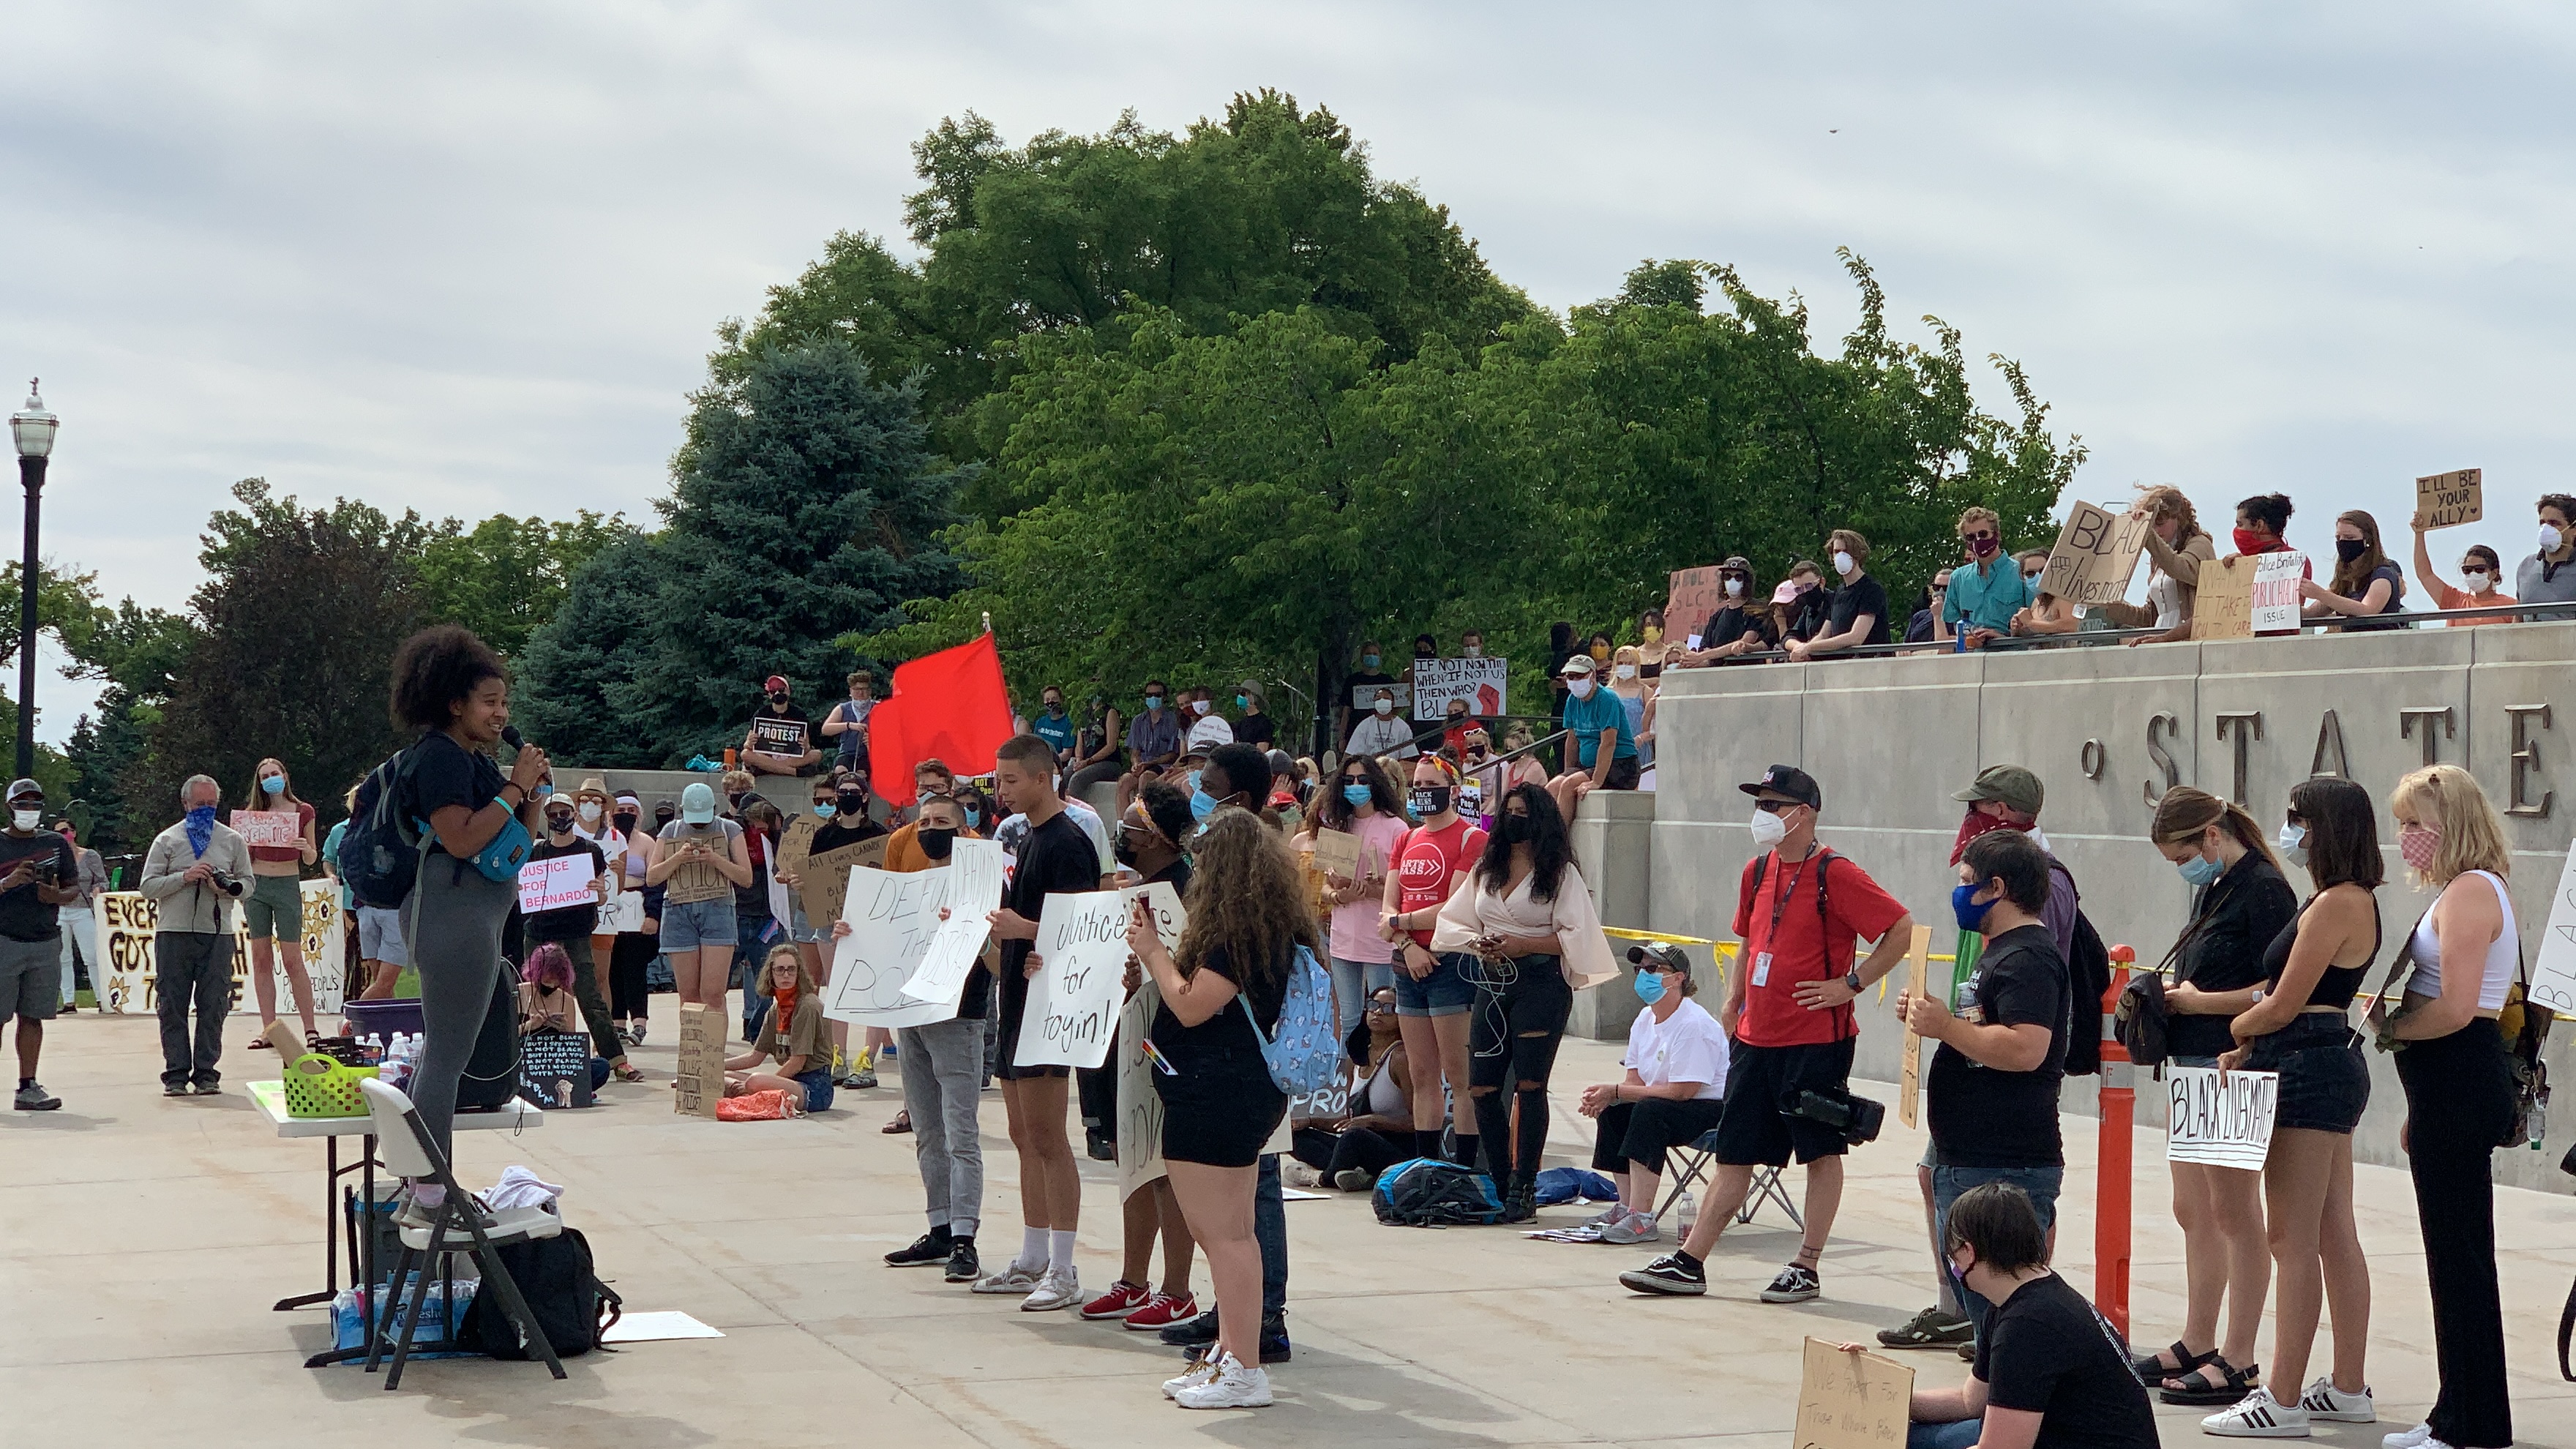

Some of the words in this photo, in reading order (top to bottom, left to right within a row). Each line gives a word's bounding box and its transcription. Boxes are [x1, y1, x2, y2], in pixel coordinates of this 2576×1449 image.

[2419, 476, 2447, 493] I'LL
[2459, 471, 2477, 487] BE
[2438, 489, 2469, 508] YOUR
[2430, 506, 2467, 527] ALLY
[2070, 509, 2149, 556] BLAC
[2256, 555, 2275, 573] Police
[2277, 552, 2305, 573] Brutality
[2252, 581, 2276, 609] PUBLIC
[2277, 577, 2301, 607] HEALTH
[2264, 610, 2285, 623] ISSUE
[1416, 660, 1434, 672] IF
[1439, 659, 1461, 671] NOT
[1448, 671, 1461, 681] IF
[1465, 670, 1488, 680] NOT
[1491, 669, 1505, 679] US
[1417, 688, 1446, 700] THEN
[1447, 682, 1476, 696] WHO?
[1421, 700, 1448, 719] BL
[758, 726, 801, 742] PROTEST
[975, 778, 988, 787] NOT
[797, 822, 819, 835] TA
[782, 837, 800, 846] FOR
[782, 853, 807, 863] NOT
[809, 858, 823, 870] All
[829, 853, 852, 865] Lives
[852, 839, 882, 856] CANNOT
[1401, 859, 1426, 868] ARTS
[522, 861, 569, 877] JUSTICE
[668, 861, 729, 891] ACTION
[1400, 867, 1424, 875] PASS
[523, 880, 547, 892] FOR
[954, 843, 996, 916] DEFUND
[526, 889, 591, 908] BERNARDO
[869, 877, 949, 924] DEFU
[105, 897, 158, 928] EVER
[109, 931, 154, 973] GOT
[901, 928, 938, 958] THE
[835, 959, 924, 1009] POL
[1063, 956, 1090, 995] for
[1290, 1087, 1348, 1115] PRO
[2171, 1074, 2221, 1140] BLACK
[2223, 1075, 2250, 1140] LIVES
